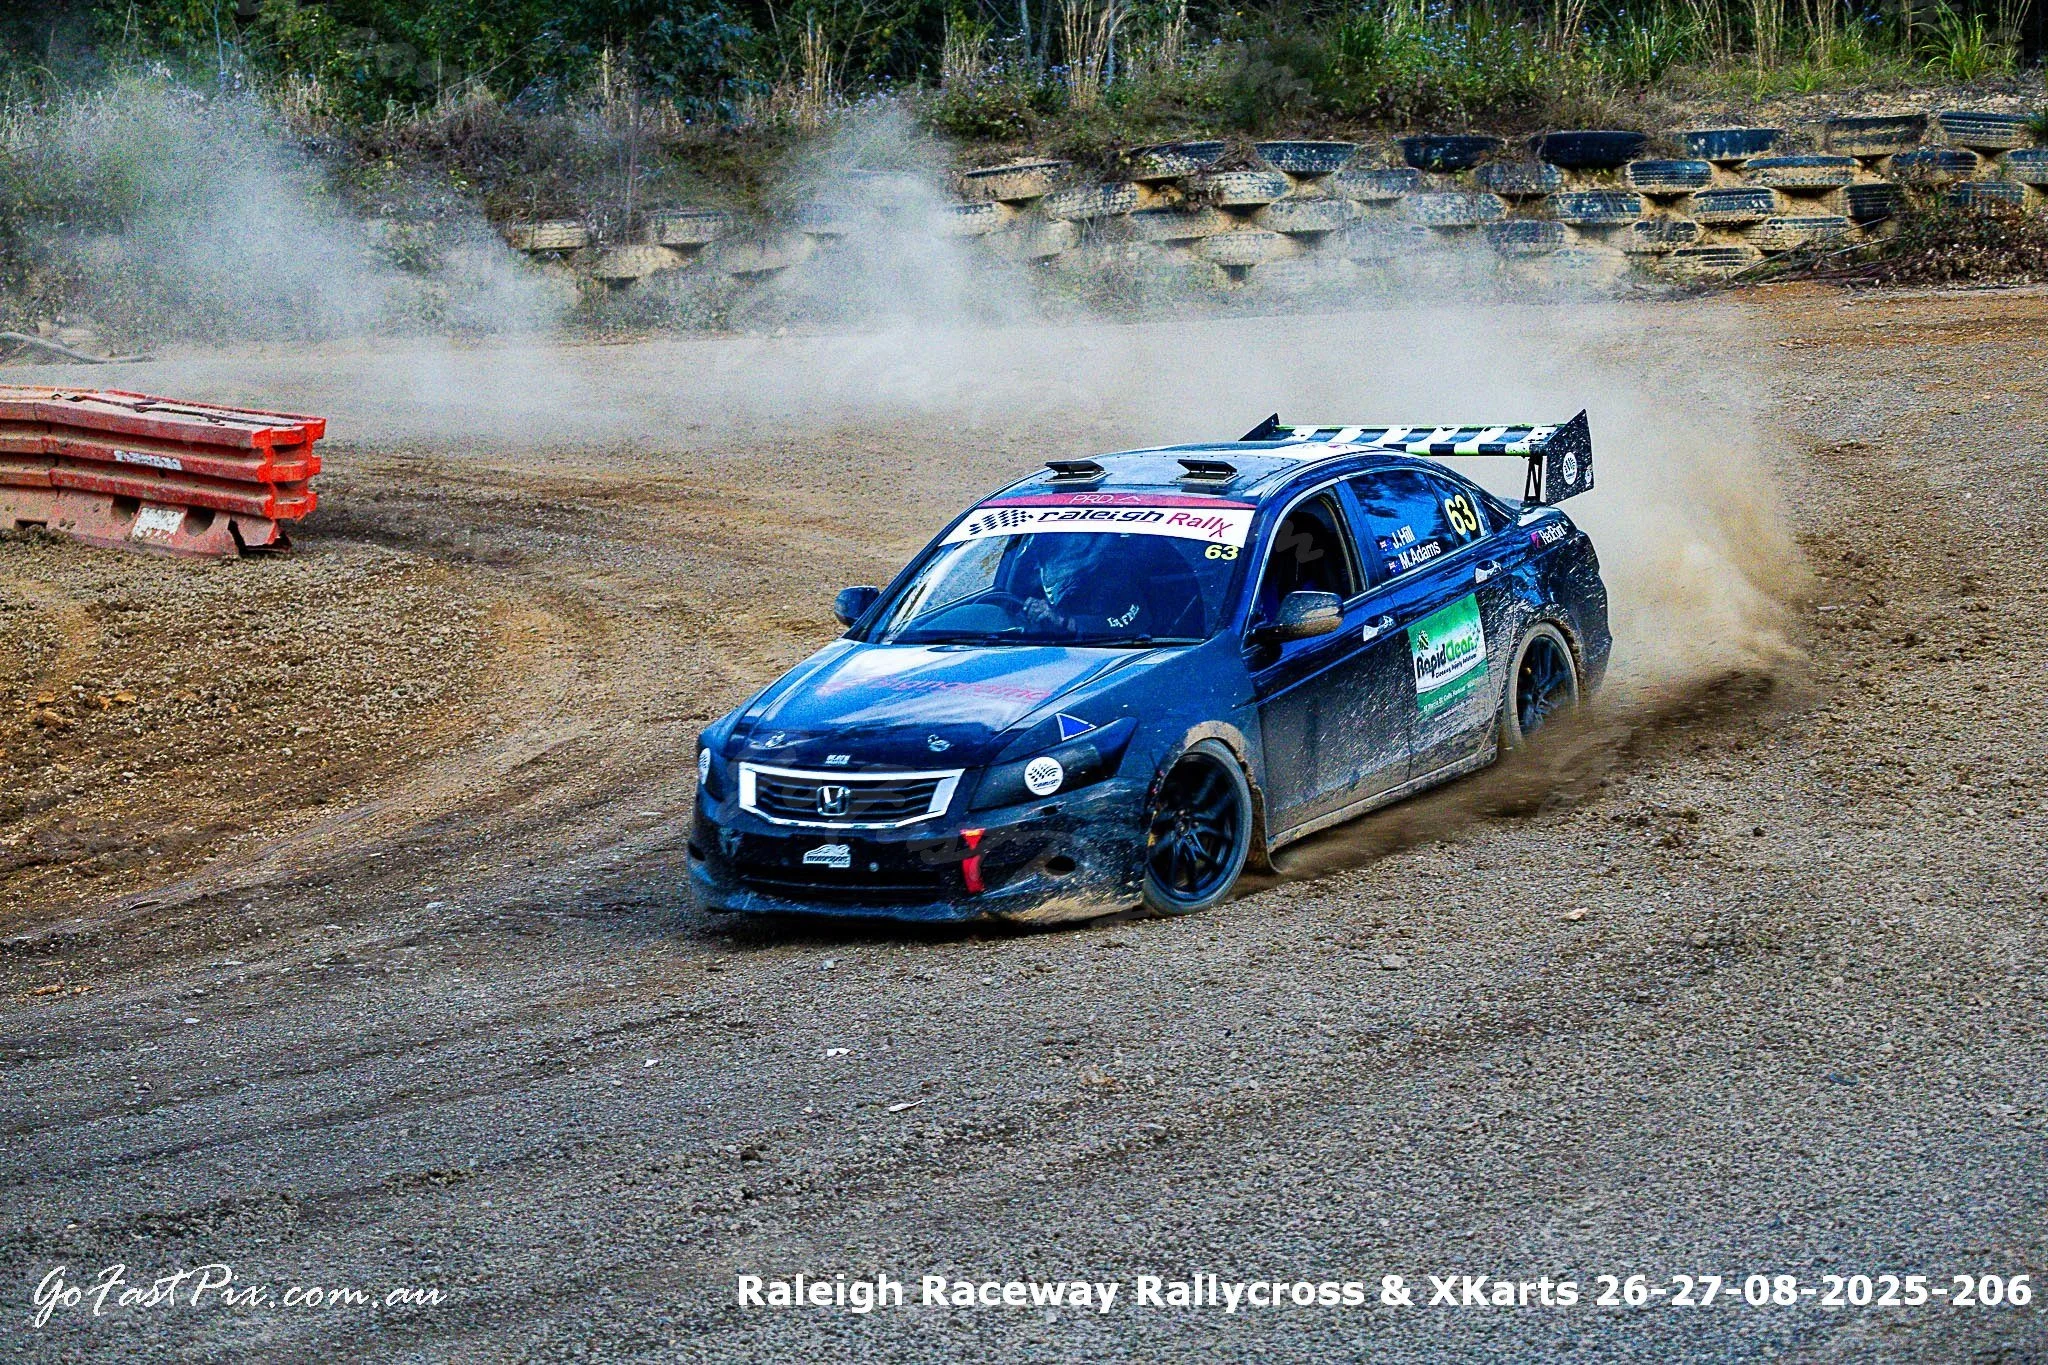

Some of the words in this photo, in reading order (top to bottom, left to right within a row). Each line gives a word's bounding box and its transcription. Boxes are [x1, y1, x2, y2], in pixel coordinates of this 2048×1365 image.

[1037, 509, 1165, 522] raleigh
[1444, 494, 1477, 536] 63
[1204, 544, 1239, 561] 63
[1398, 541, 1442, 570] M.Adams
